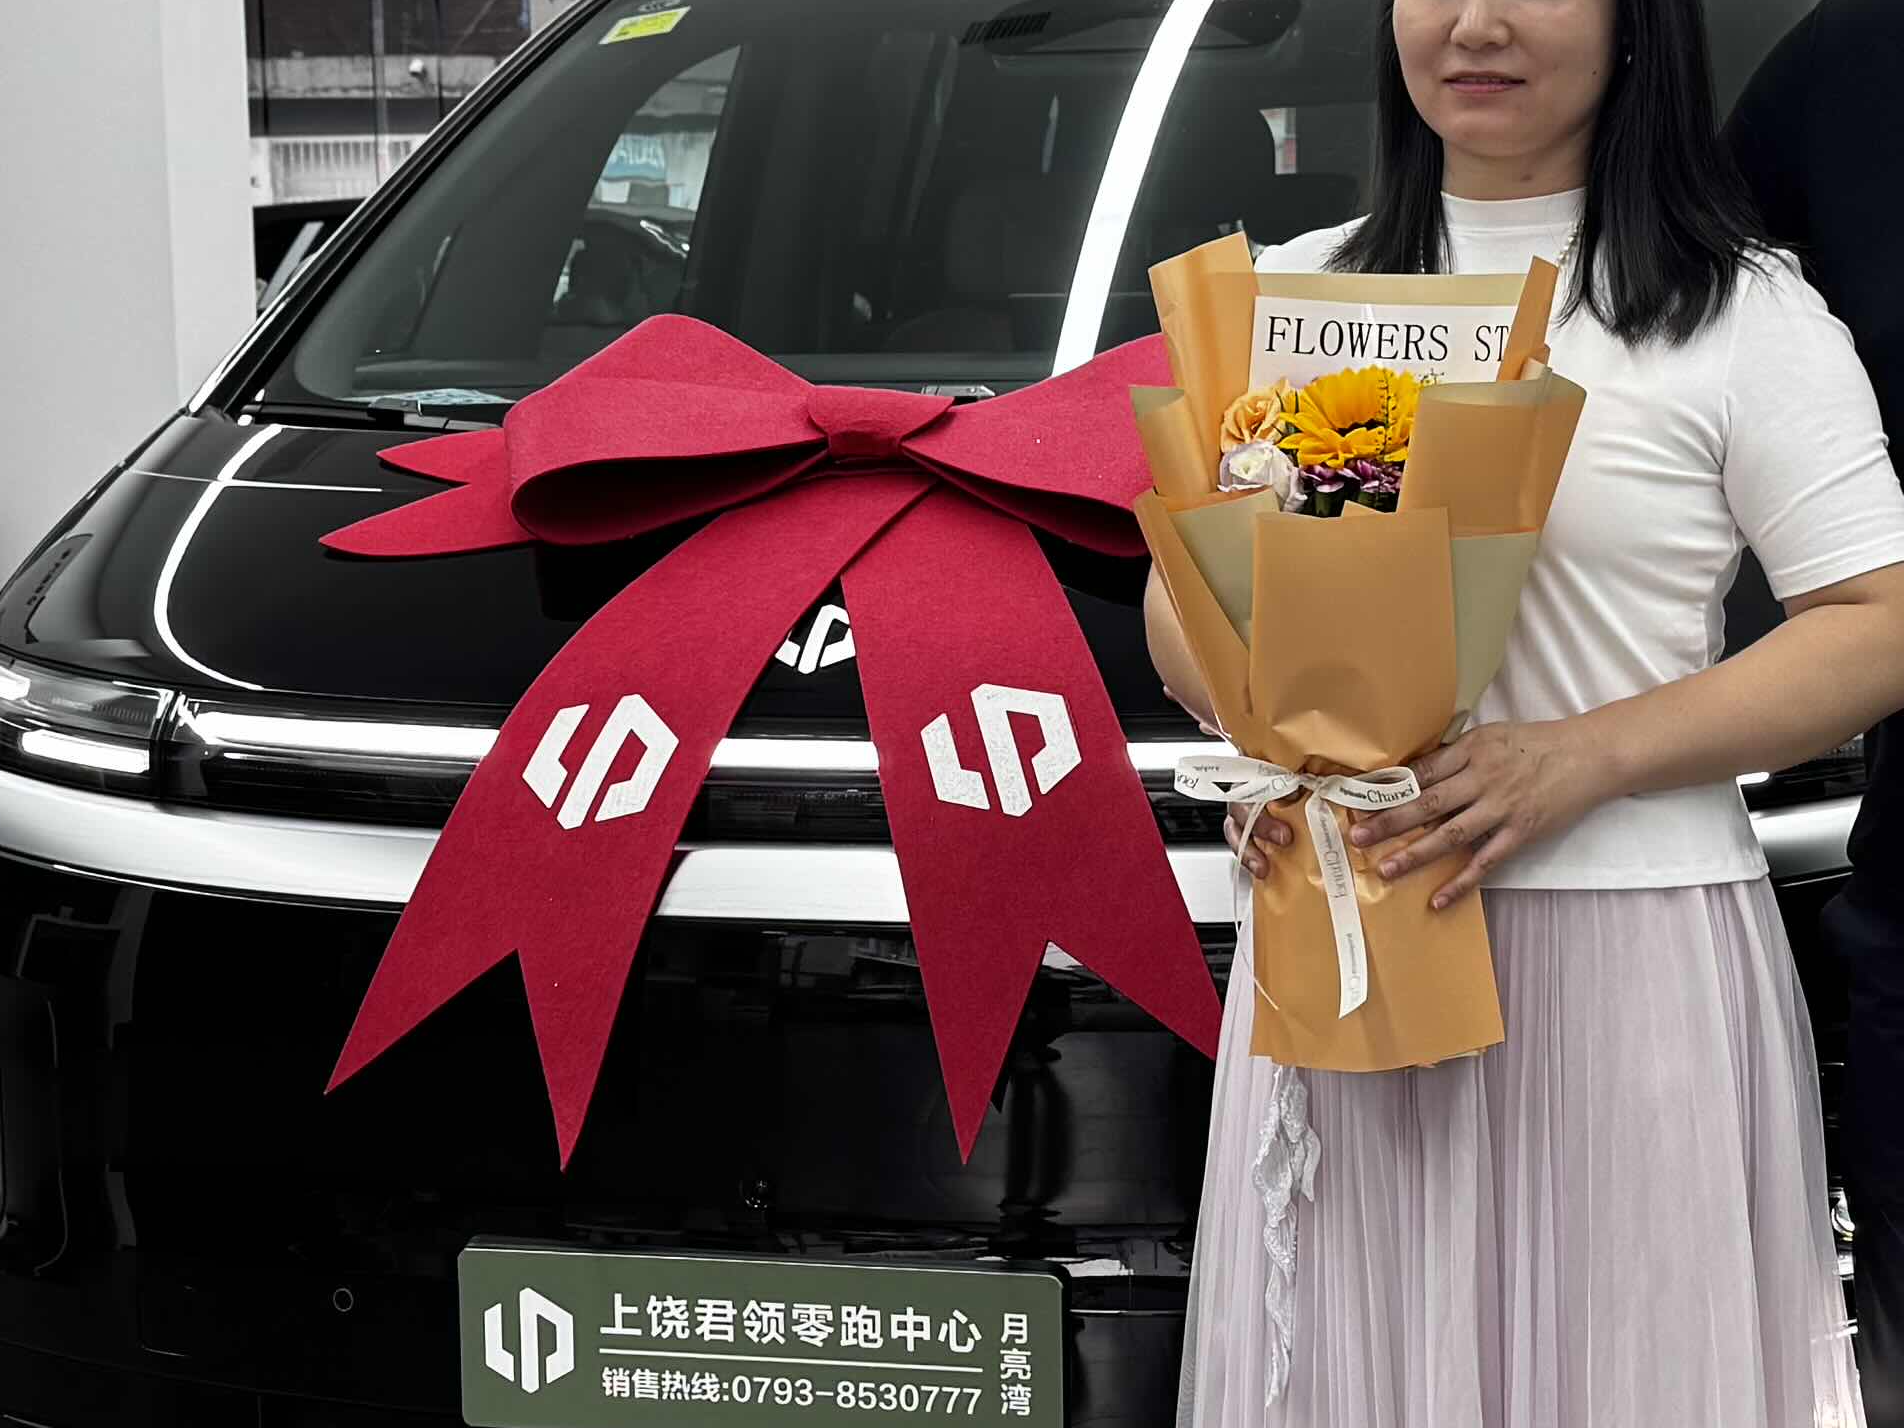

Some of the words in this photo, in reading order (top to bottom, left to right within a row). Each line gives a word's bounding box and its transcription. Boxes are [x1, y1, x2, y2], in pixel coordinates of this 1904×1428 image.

[1264, 315, 1450, 362] FLOWERS
[599, 1292, 983, 1354] 上饶君领零跑中心
[601, 1366, 982, 1417] 销售热线:0793-8530777
[999, 1313, 1033, 1417] 月亮湾
